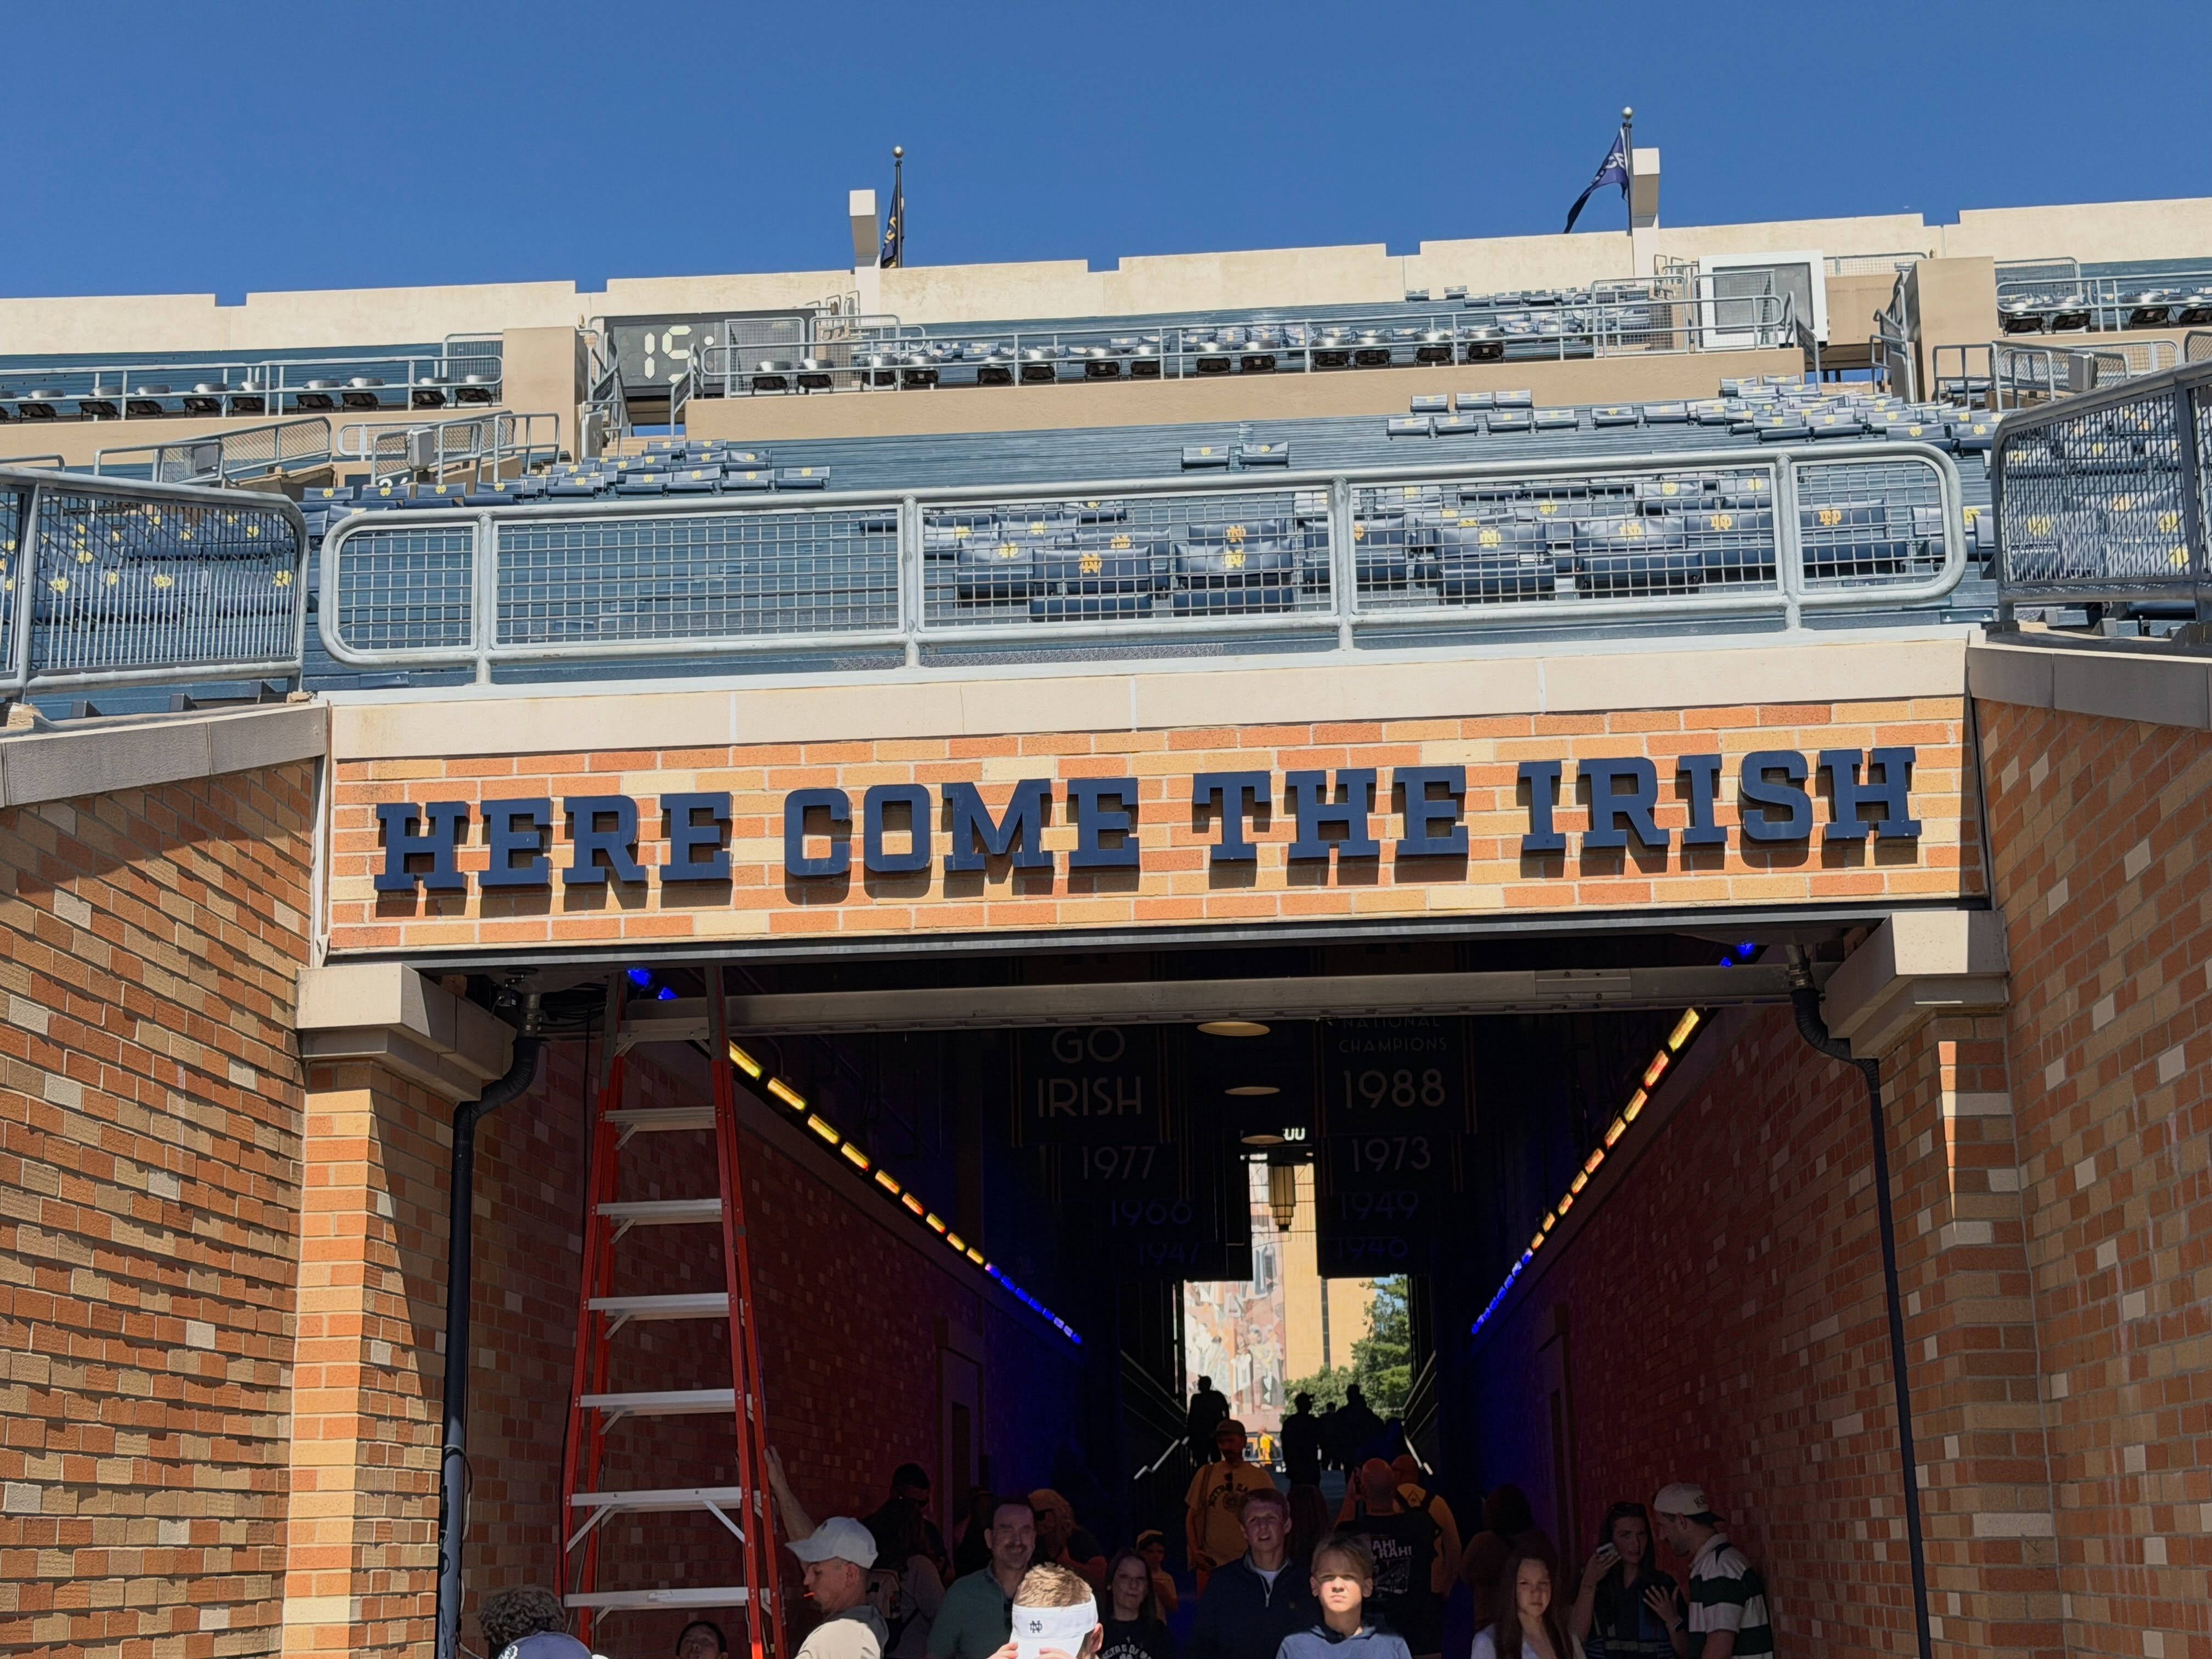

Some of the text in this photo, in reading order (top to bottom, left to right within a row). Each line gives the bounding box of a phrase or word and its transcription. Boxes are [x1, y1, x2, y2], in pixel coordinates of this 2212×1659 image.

[374, 746, 1922, 890] HERE COME THE IRISH
[1051, 1026, 1125, 1064] GO
[1339, 1037, 1448, 1054] CHAMPIONS
[1037, 1076, 1142, 1119] IRISH
[1344, 1069, 1446, 1109] 1988
[1081, 1145, 1156, 1180] 1977
[1351, 1136, 1431, 1172] 1973
[1341, 1190, 1420, 1221] 1949
